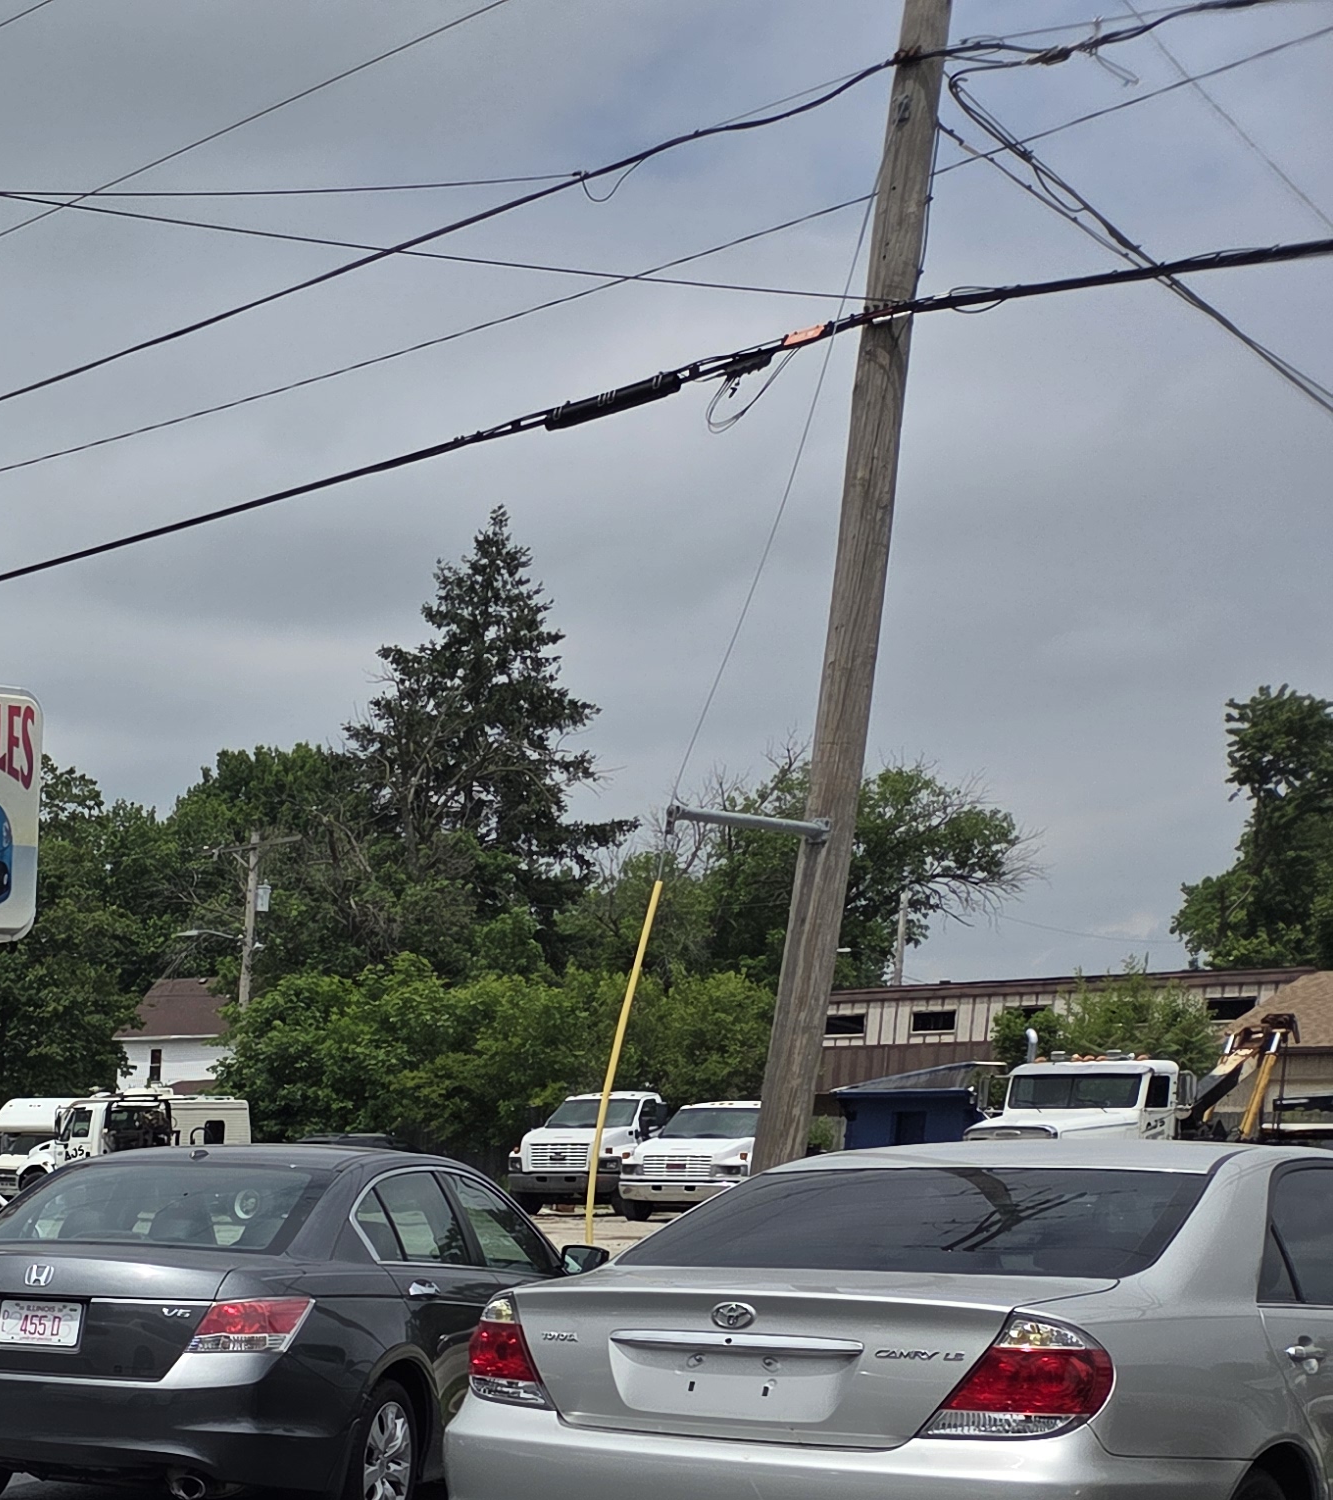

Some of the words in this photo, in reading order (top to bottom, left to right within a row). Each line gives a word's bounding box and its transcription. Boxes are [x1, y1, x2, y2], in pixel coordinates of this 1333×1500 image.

[26, 1304, 55, 1313] ILLINOIS
[162, 1307, 192, 1318] V6
[20, 1314, 48, 1336] 455
[874, 1349, 940, 1361] CAMRY
[943, 1352, 965, 1361] LE
